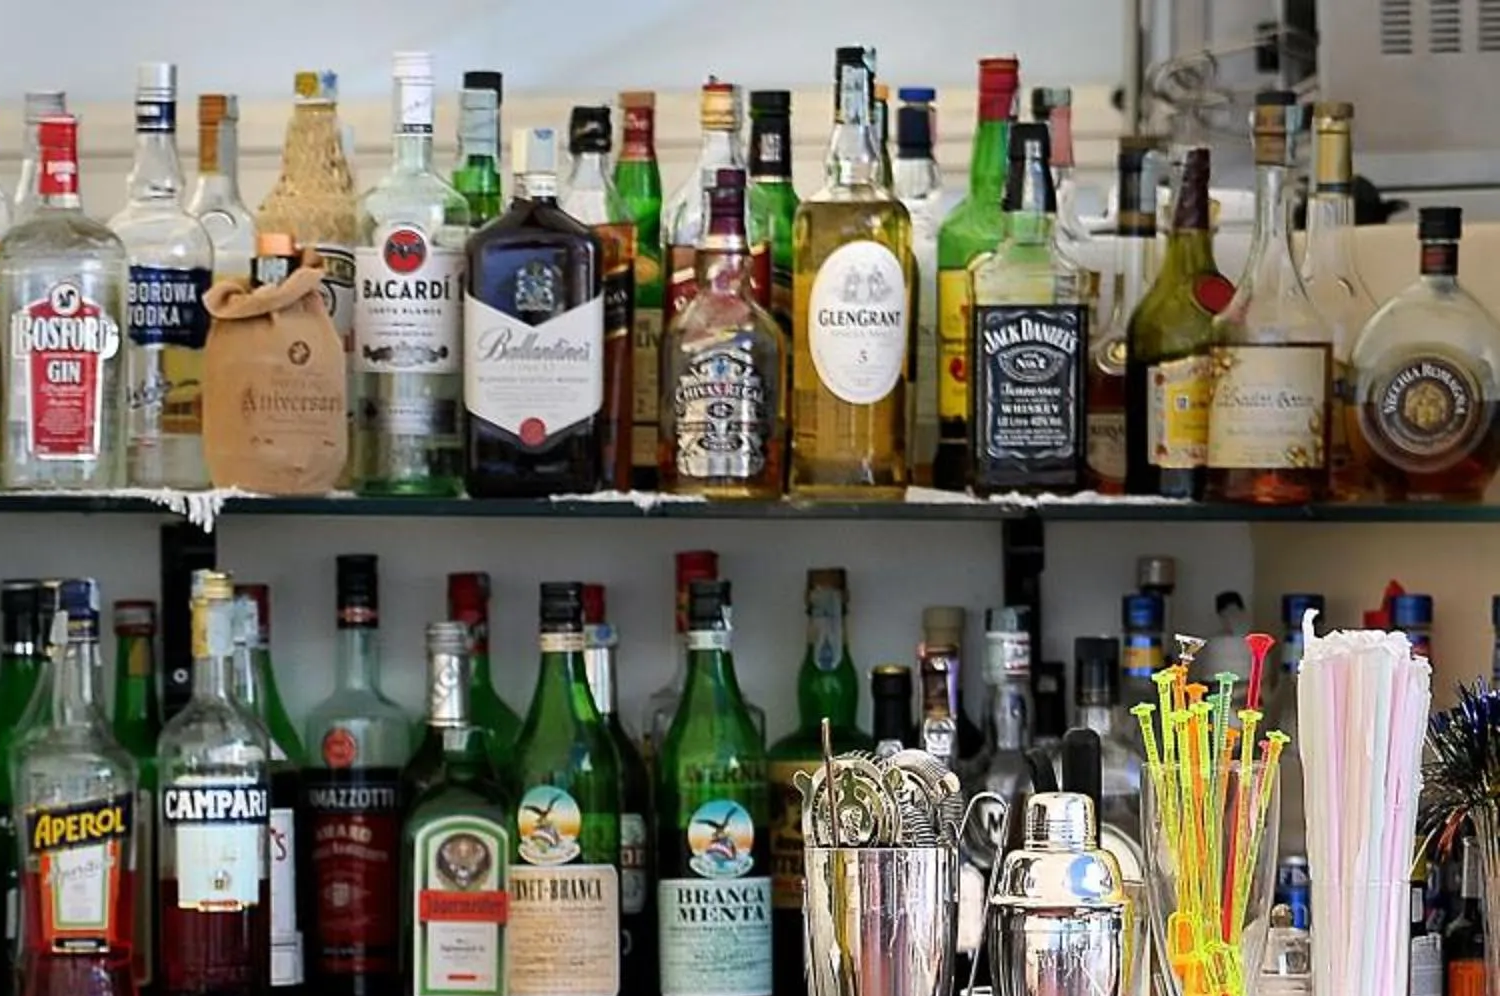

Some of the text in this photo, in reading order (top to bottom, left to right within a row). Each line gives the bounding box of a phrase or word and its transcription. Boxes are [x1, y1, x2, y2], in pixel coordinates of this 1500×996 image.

[363, 275, 452, 300] BACARDÍ
[983, 323, 1021, 355] JACK
[48, 360, 82, 384] GIN
[165, 788, 268, 819] CAMPARI
[33, 807, 126, 848] APEROL
[676, 888, 765, 905] BRANCA
[677, 905, 766, 923] MENTA
